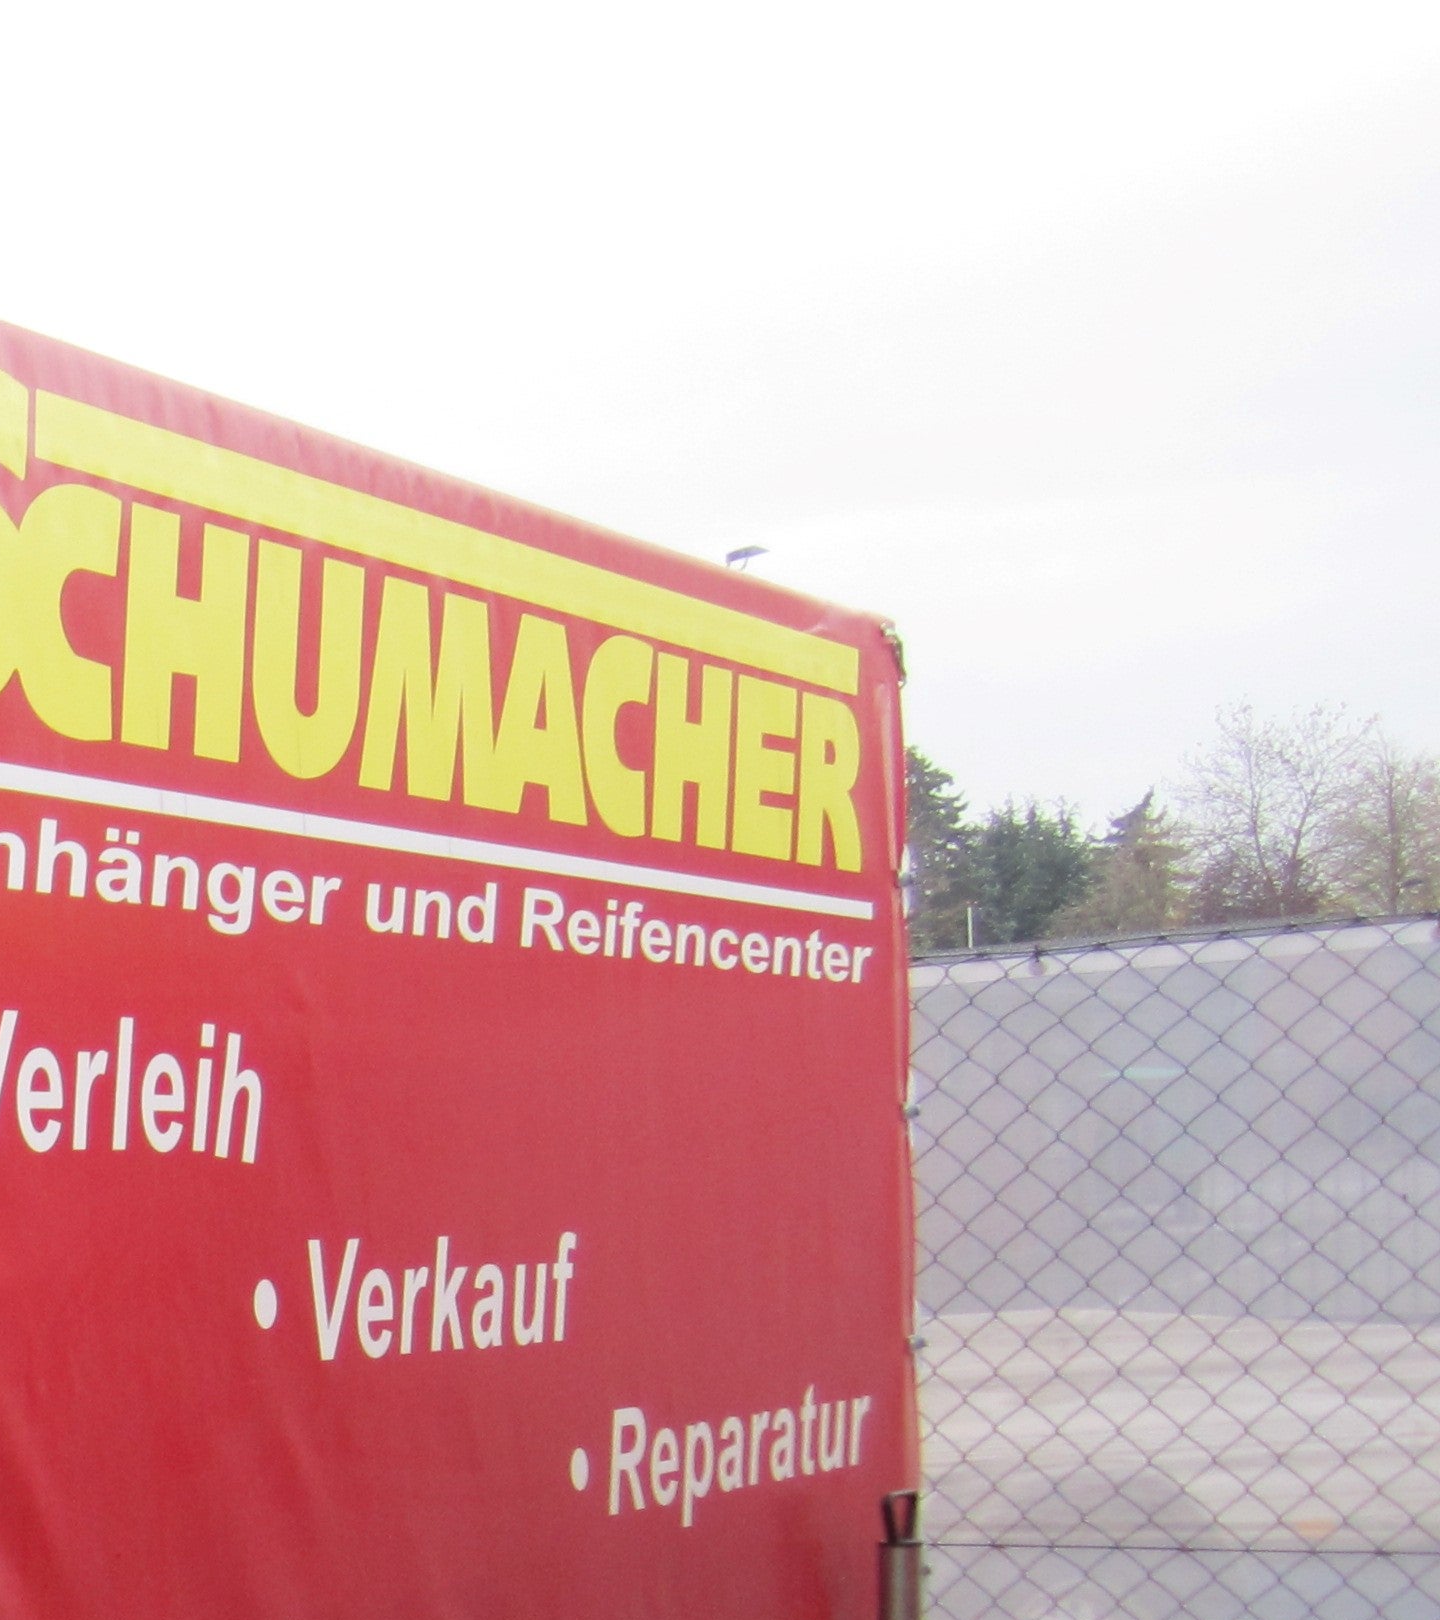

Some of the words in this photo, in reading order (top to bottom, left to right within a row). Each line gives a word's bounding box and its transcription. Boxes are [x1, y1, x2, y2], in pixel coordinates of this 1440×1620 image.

[366, 882, 497, 943] und
[522, 888, 873, 983] Reifencenter
[309, 1232, 576, 1360] Verkauf
[610, 1387, 869, 1527] Reparatur
